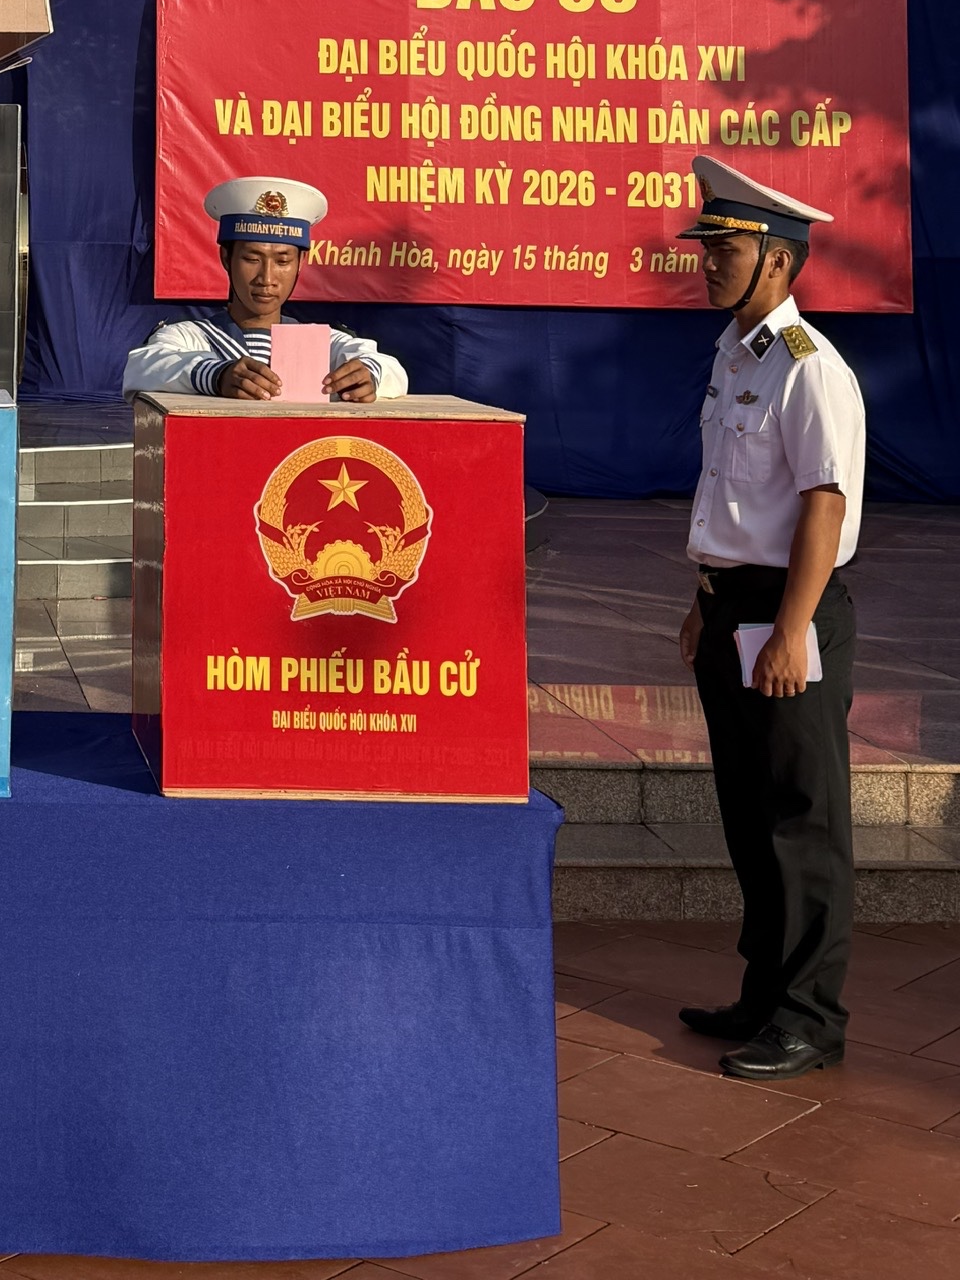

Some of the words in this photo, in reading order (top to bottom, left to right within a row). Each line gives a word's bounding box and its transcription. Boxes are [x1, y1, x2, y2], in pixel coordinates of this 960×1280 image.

[318, 38, 369, 82] ĐẠI
[378, 25, 446, 77] BIỂU
[457, 29, 536, 82] QUỐC
[545, 36, 596, 87] HỘI
[606, 37, 688, 82] KHÓA
[697, 45, 745, 82] XVI
[214, 92, 253, 136] VÀ
[262, 100, 312, 144] ĐẠI
[322, 87, 391, 139] BIỂU
[401, 96, 450, 148] HỘI
[460, 93, 542, 142] ĐỒNG
[552, 99, 637, 144] NHÂN
[648, 101, 710, 146] DÂN
[719, 101, 780, 146] CÁC
[790, 97, 852, 147] CẤP
[366, 158, 465, 211] NHIỆM
[475, 160, 514, 205] KỲ
[523, 170, 596, 207] 2026
[627, 172, 696, 209] 2031
[247, 221, 268, 234] QUÂN
[269, 222, 289, 237] VIỆT
[289, 226, 303, 237] NAM
[307, 240, 381, 267] Khánh
[389, 240, 439, 273] Hòa,
[447, 241, 505, 275] ngày
[512, 244, 537, 270] 15
[543, 246, 609, 279] tháng
[629, 247, 643, 273] 3
[649, 248, 698, 274] năm
[316, 586, 343, 597] VIỆT
[345, 587, 370, 599] NAM
[206, 647, 271, 691] HÒM
[281, 647, 364, 694] PHIẾU
[373, 648, 430, 696] BẦU
[439, 649, 480, 697] CỬ
[272, 710, 291, 732] ĐẠI
[293, 704, 316, 730] BIỂU
[319, 706, 347, 732] QUỐC
[349, 709, 367, 735] HỘI
[369, 709, 398, 732] KHÓA
[400, 714, 417, 733] XVI
